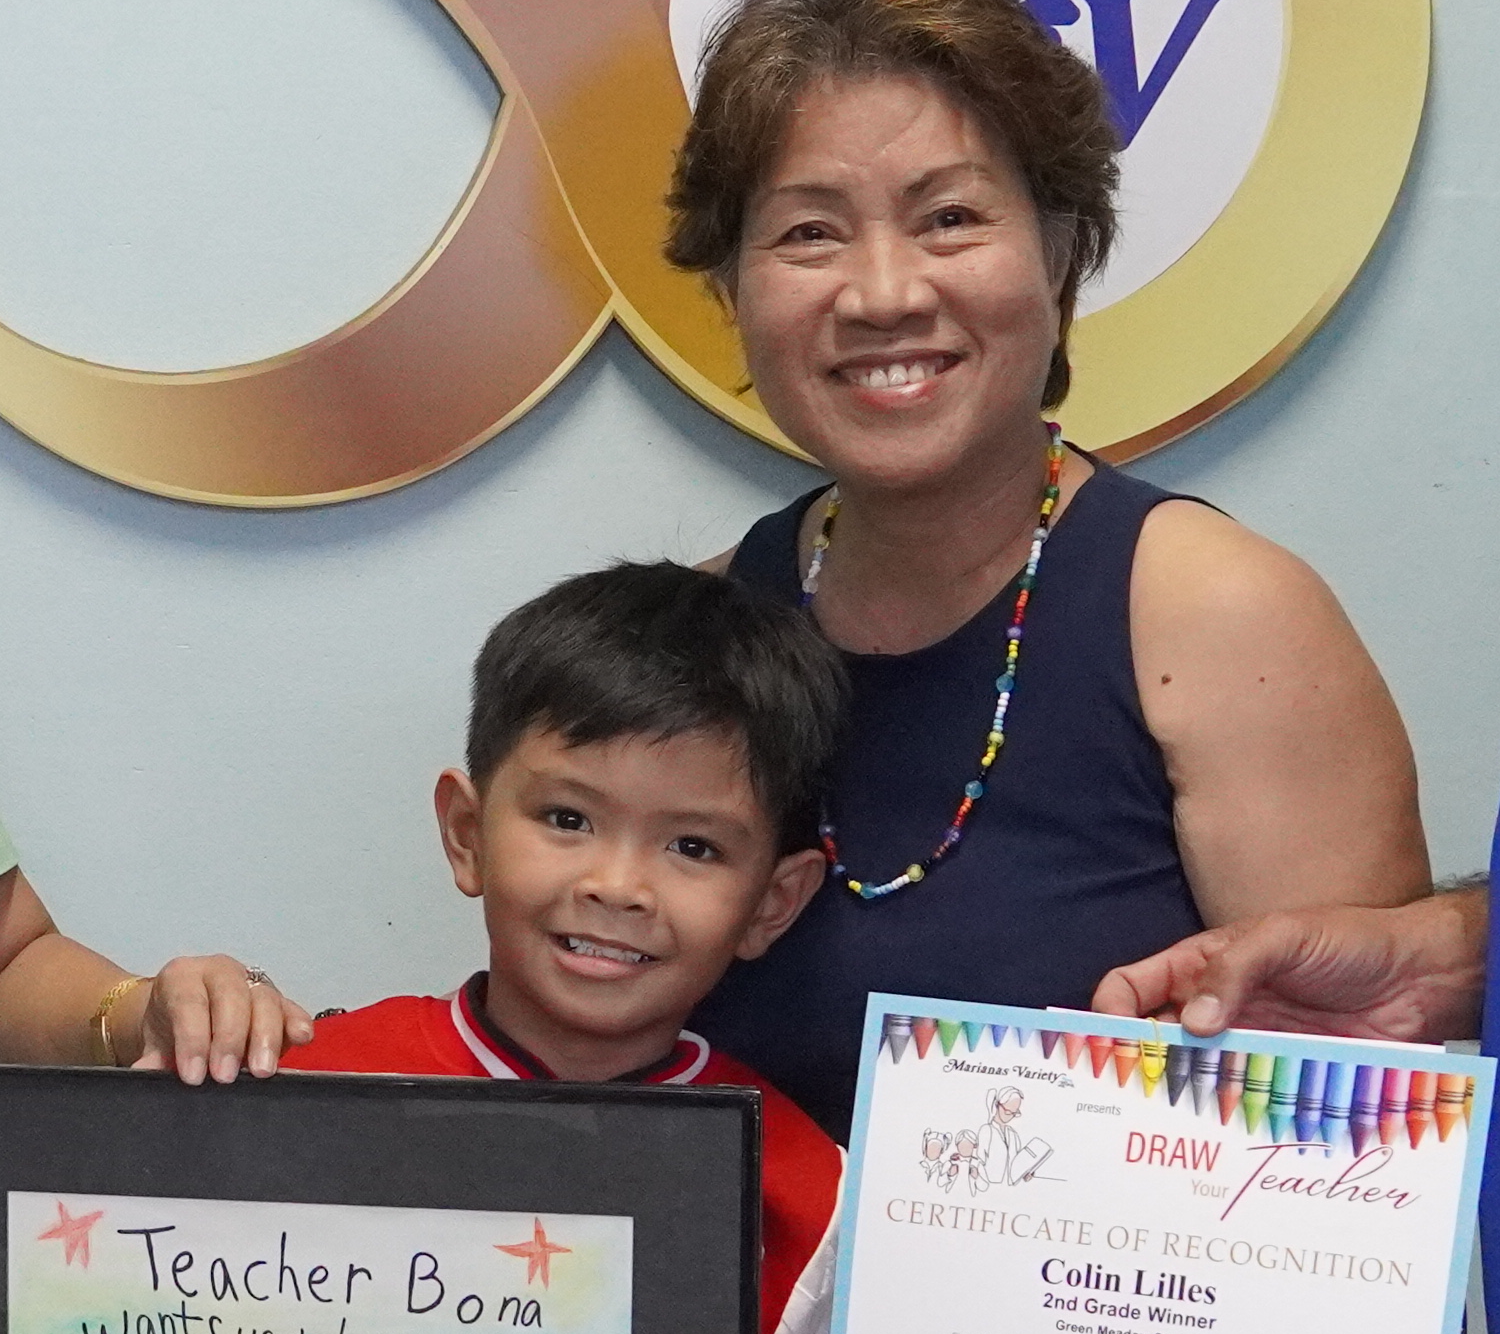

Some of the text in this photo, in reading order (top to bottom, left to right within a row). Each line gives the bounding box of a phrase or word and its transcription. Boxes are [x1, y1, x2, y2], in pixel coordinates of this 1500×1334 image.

[943, 1059, 1009, 1076] Marianas
[1012, 1065, 1067, 1084] Variety
[1076, 1102, 1122, 1117] presents
[1125, 1131, 1222, 1172] DRAW
[1191, 1179, 1229, 1200] Your
[1220, 1142, 1422, 1221] Teacher
[886, 1198, 1413, 1287] CERTIFICATE OF RECOGNITION
[116, 1224, 542, 1328] Teacher Bona
[1040, 1257, 1218, 1306] Colin Lilles
[1042, 1292, 1218, 1330] 2nd Grade Winner
